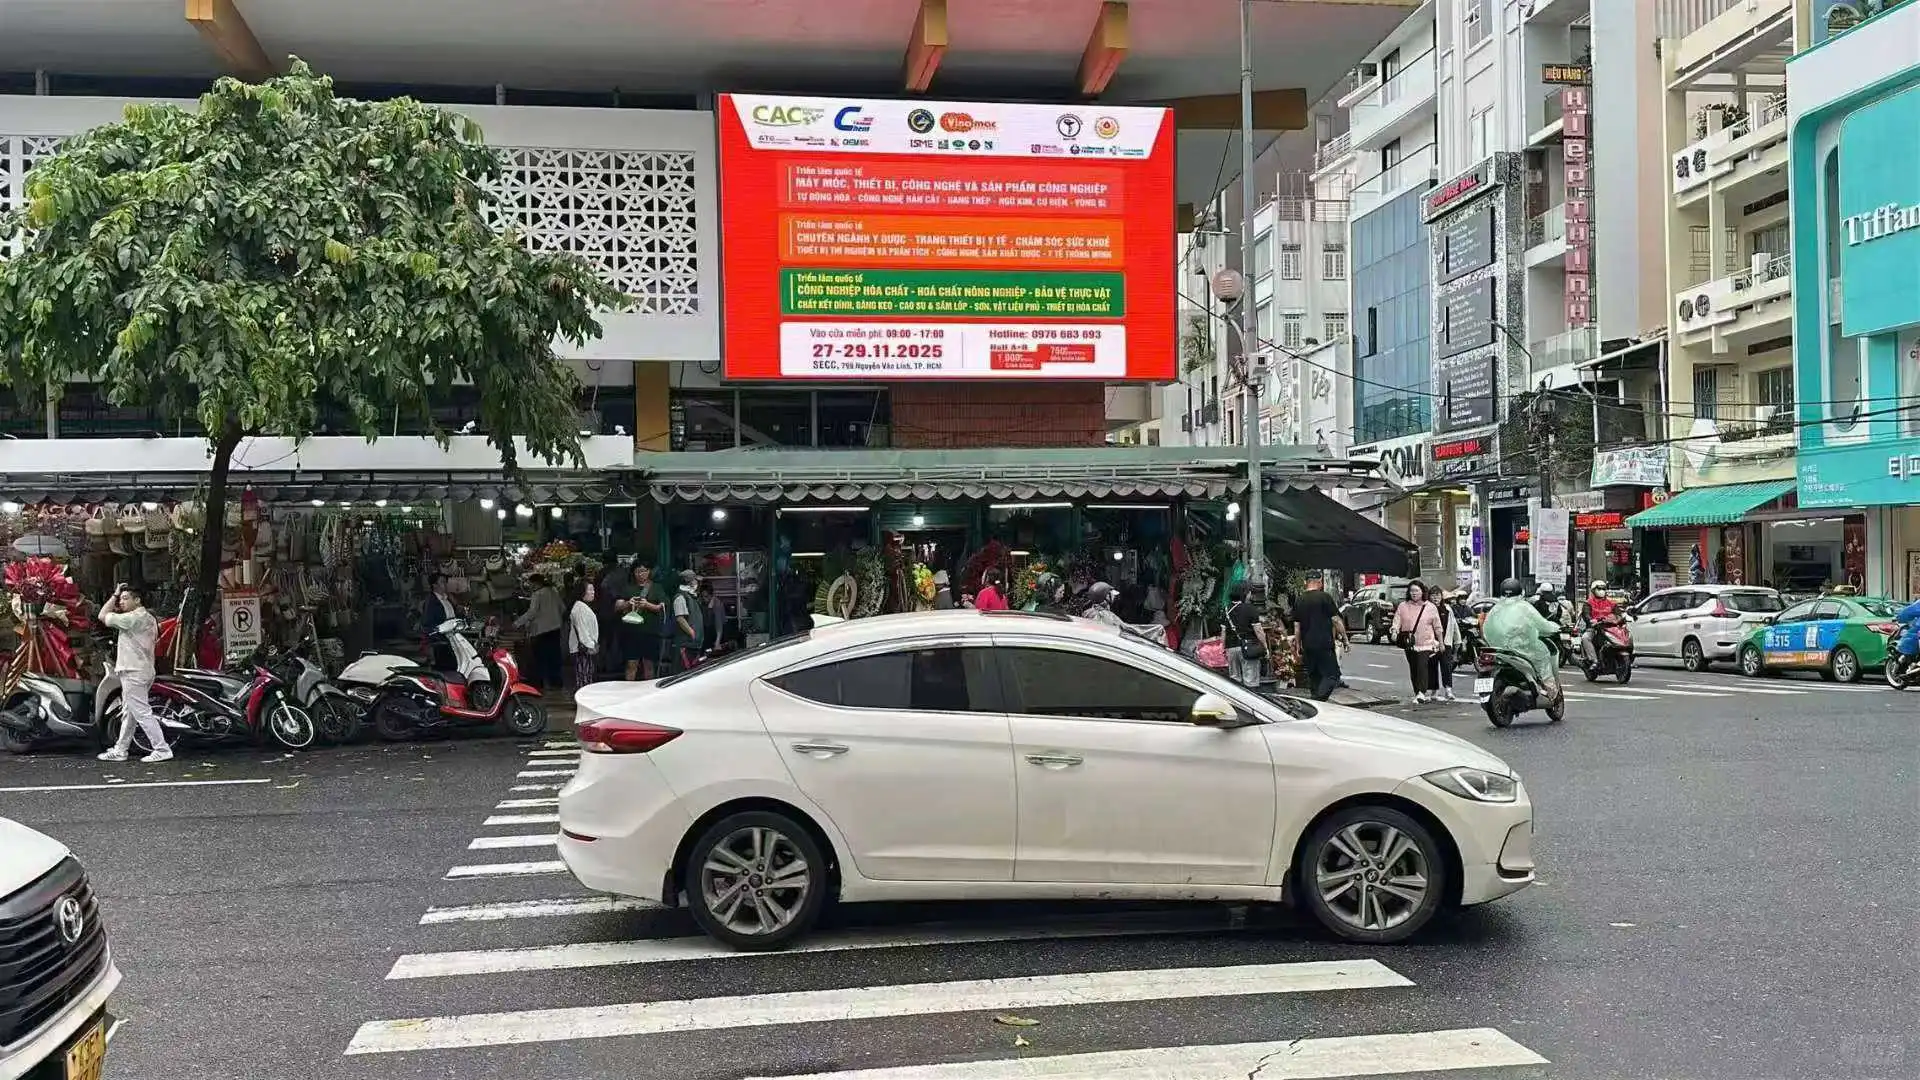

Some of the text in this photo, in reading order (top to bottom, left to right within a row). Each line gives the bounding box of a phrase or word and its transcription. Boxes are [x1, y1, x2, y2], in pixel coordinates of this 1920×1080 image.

[752, 106, 802, 123] CAC
[796, 177, 818, 188] MÁY
[854, 176, 881, 190] THIẾT
[902, 178, 930, 190] CÔNG
[934, 179, 961, 194] NGHỆ
[964, 179, 978, 191] VÀ
[981, 180, 1002, 192] SẢN
[1005, 180, 1036, 193] PHẨM
[1039, 181, 1068, 193] CÔNG
[1070, 182, 1107, 195] NGHIỆP
[858, 193, 881, 203] CÔNG
[882, 194, 904, 204] NGHỆ
[797, 232, 834, 243] CHUYÊN
[837, 232, 870, 243] NGÀNH
[881, 234, 906, 245] DƯỢC
[915, 235, 946, 244] TRANG
[948, 234, 973, 245] THIẾT
[1016, 235, 1042, 246] CHĂM
[798, 273, 863, 283] Triển lãm quốc tế
[798, 284, 824, 295] CÔNG
[826, 285, 861, 298] NGHIỆP
[885, 283, 909, 296] CHẤT
[938, 284, 962, 296] CHẤT
[964, 286, 990, 296] NÔNG
[992, 286, 1026, 299] NGHIỆP
[1035, 285, 1053, 297] BẢO
[1055, 286, 1066, 299] VỆ
[1068, 288, 1092, 300] THỰC
[1094, 287, 1111, 300] VẬT
[798, 298, 816, 309] CHẤT
[818, 298, 833, 309] KẾT
[878, 302, 892, 310] KEO
[899, 301, 914, 310] CAO
[916, 302, 926, 310] SU
[1008, 301, 1023, 312] LIỆU
[1046, 301, 1065, 311] THIẾT
[1092, 301, 1110, 312] CHẤT
[810, 328, 826, 338] Vào
[828, 329, 843, 338] cửa
[846, 328, 866, 338] miễn
[886, 329, 911, 338] 09:00
[920, 329, 944, 338] 17:00
[989, 330, 1101, 339] Hotline: 0976 683 693
[812, 344, 943, 358] 27-29.11.2025
[813, 361, 840, 370] SECC,
[1774, 635, 1790, 647] 315
